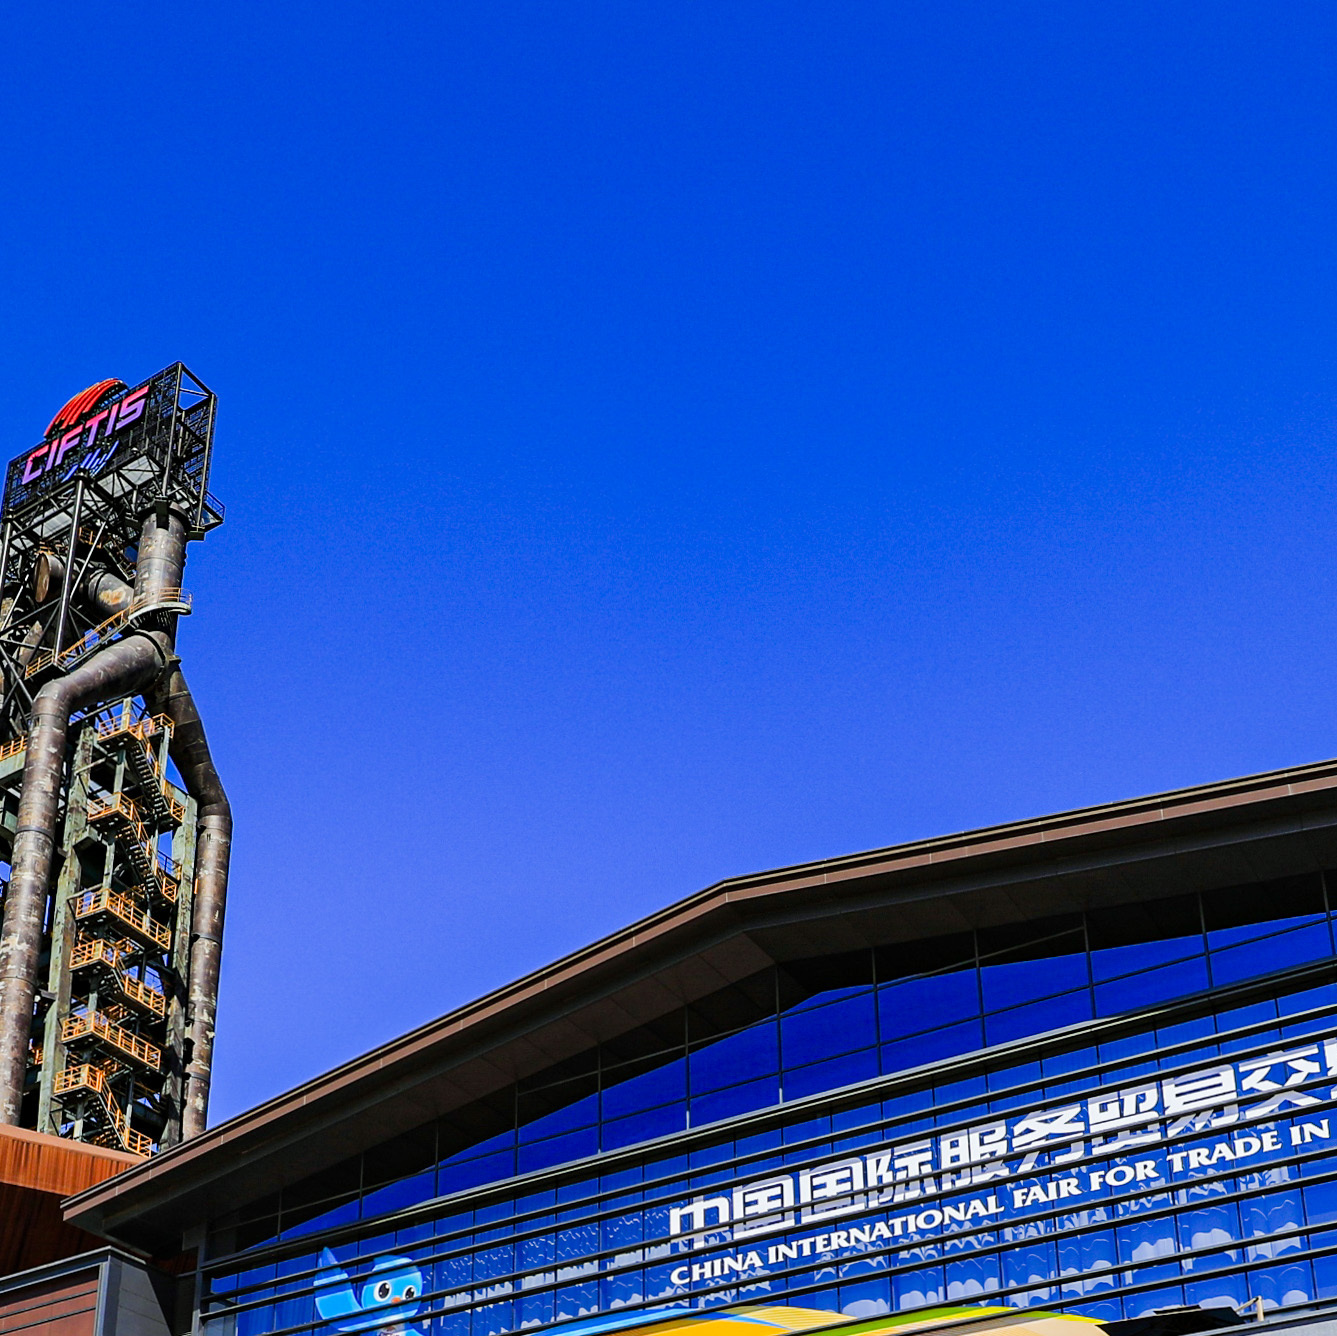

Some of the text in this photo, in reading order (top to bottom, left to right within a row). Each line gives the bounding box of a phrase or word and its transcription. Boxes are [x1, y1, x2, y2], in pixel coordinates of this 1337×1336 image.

[21, 385, 150, 485] CIFTIS
[670, 1250, 762, 1285] CHINA
[767, 1196, 1005, 1264] INTERNATIONAL
[1012, 1177, 1081, 1210] FAIR
[1089, 1160, 1159, 1192] FOR
[1166, 1129, 1282, 1171] TRADE
[1289, 1118, 1331, 1148] IN
